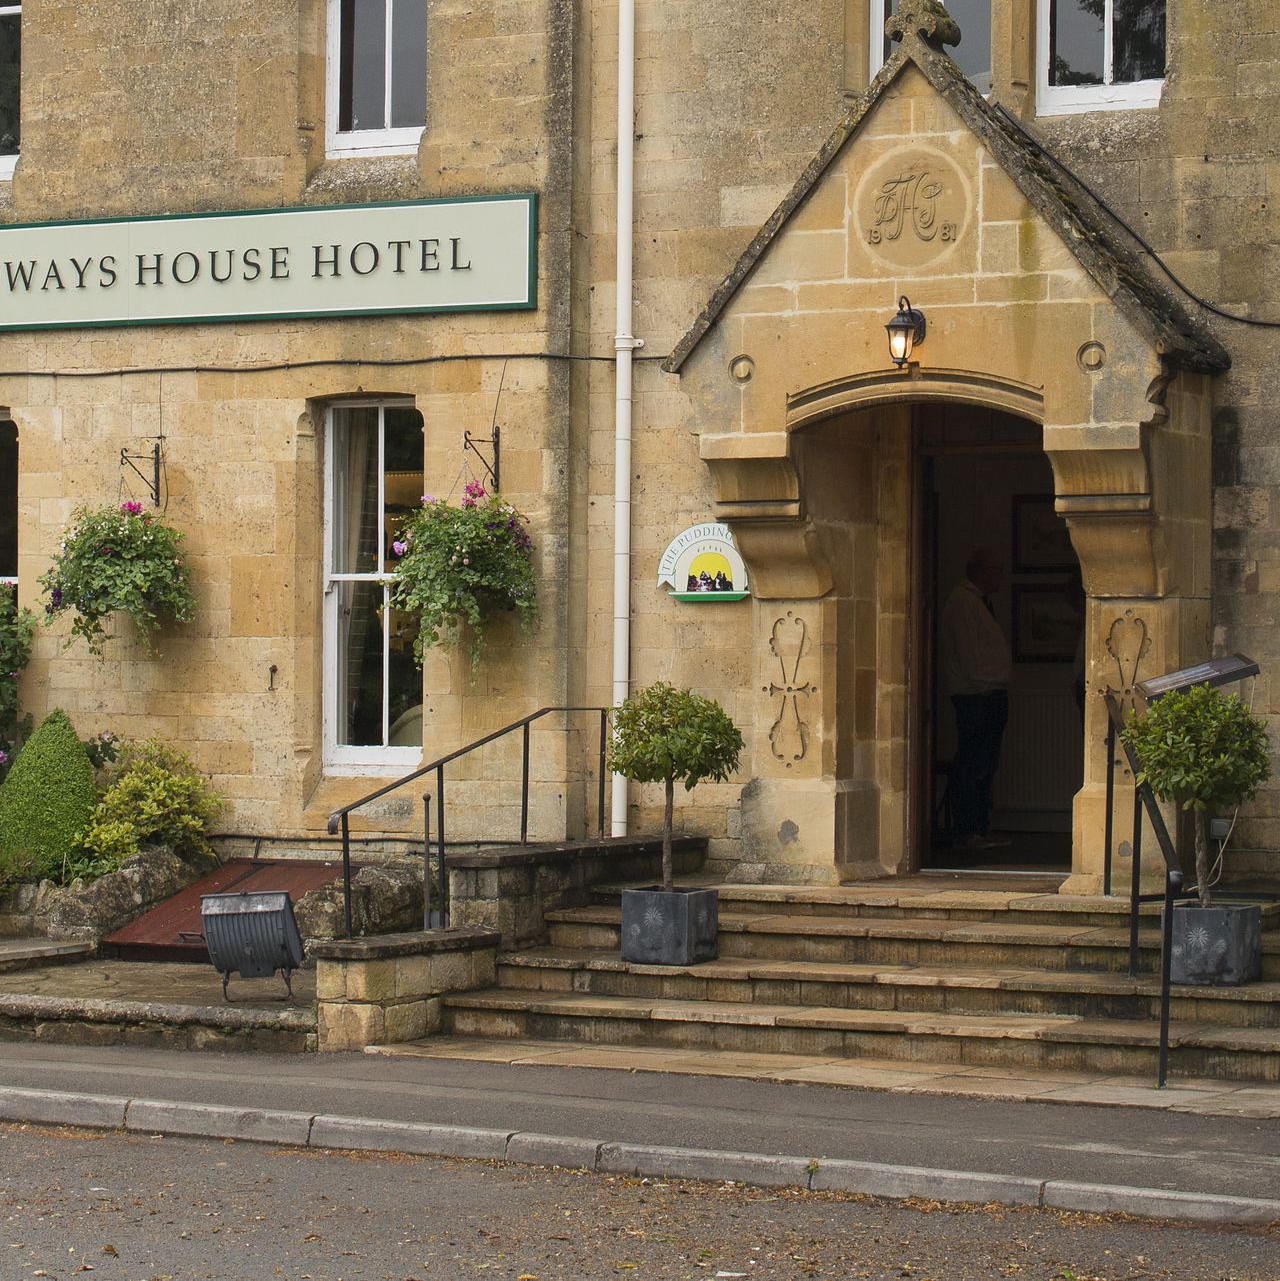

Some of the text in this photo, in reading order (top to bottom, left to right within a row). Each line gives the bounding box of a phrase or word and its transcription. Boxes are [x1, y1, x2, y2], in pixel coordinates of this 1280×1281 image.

[3, 255, 118, 293] WAYS
[135, 246, 290, 287] HOUSE
[311, 237, 473, 278] HOTEL
[661, 545, 681, 571] THE
